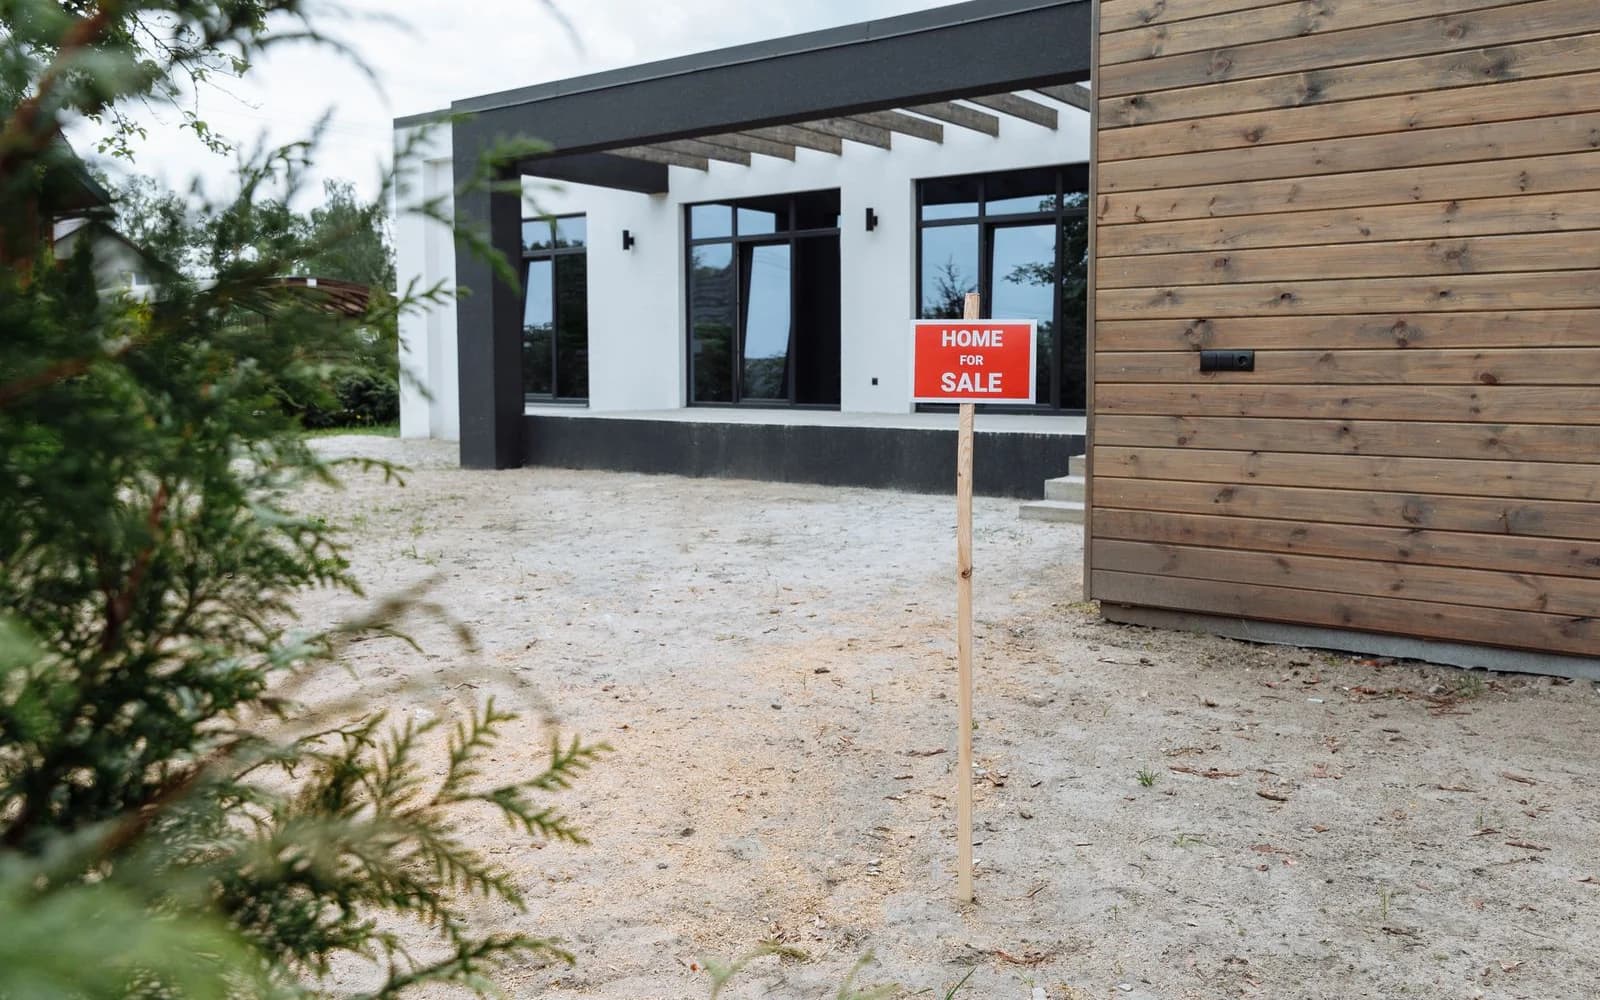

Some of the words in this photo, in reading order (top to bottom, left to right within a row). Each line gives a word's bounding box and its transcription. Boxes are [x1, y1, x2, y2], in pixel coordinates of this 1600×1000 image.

[941, 330, 1004, 347] HOME
[959, 355, 984, 366] FOR
[940, 372, 1003, 392] SALE
